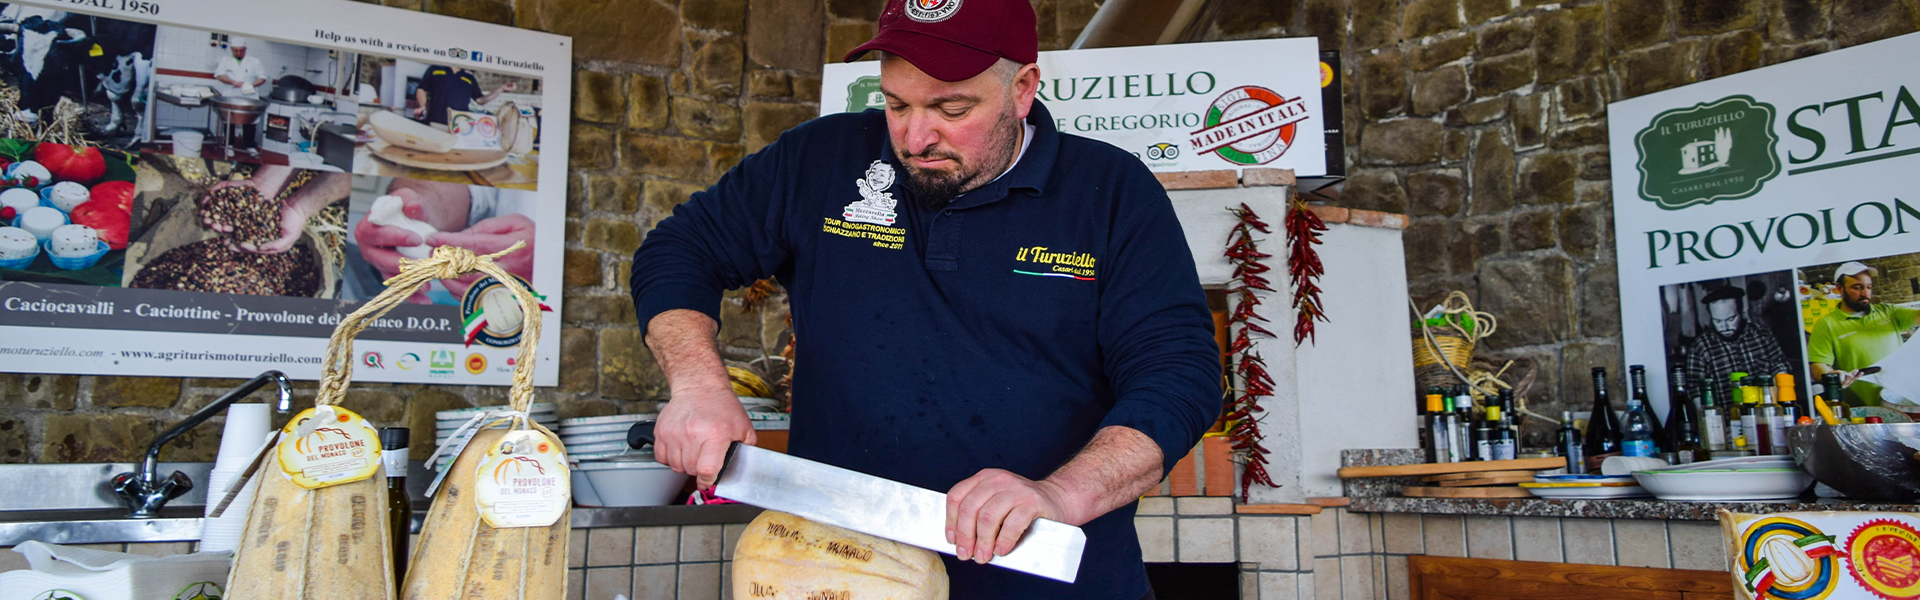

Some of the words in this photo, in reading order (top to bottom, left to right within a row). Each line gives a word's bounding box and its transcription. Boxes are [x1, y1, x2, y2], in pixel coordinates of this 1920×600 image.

[119, 0, 160, 16] 1950
[315, 29, 341, 41] Help
[359, 37, 384, 48] with
[396, 44, 430, 54] review
[433, 49, 446, 57] on
[485, 54, 493, 63] il
[494, 56, 545, 71] Turuziello
[1074, 112, 1200, 132] GREGORIO
[1189, 125, 1237, 151] MADE
[1236, 118, 1257, 134] IN
[1257, 100, 1308, 128] ITALY
[1660, 126, 1672, 136] IL
[1675, 110, 1745, 134] TURUZIELLO
[1787, 84, 1920, 165] STA
[1671, 184, 1703, 195] CASARI
[1704, 180, 1721, 190] DAL
[1723, 175, 1745, 186] 1950
[824, 217, 842, 227] TOUR
[823, 225, 861, 238] SCHIAZZANO
[867, 231, 905, 243] TRADIZIONI
[1016, 247, 1029, 262] il
[1030, 246, 1096, 268] Turuziello
[4, 297, 114, 316] Caciocavalli
[135, 303, 221, 320] Caciottine
[236, 307, 315, 325] Provolone
[318, 311, 341, 325] del
[407, 317, 452, 331] D.O.P.
[120, 349, 322, 364] www.agriturismoturuziello.com
[318, 439, 366, 453] PROVOLONE
[321, 450, 347, 459] MONACO
[512, 477, 556, 487] PROVOLONE
